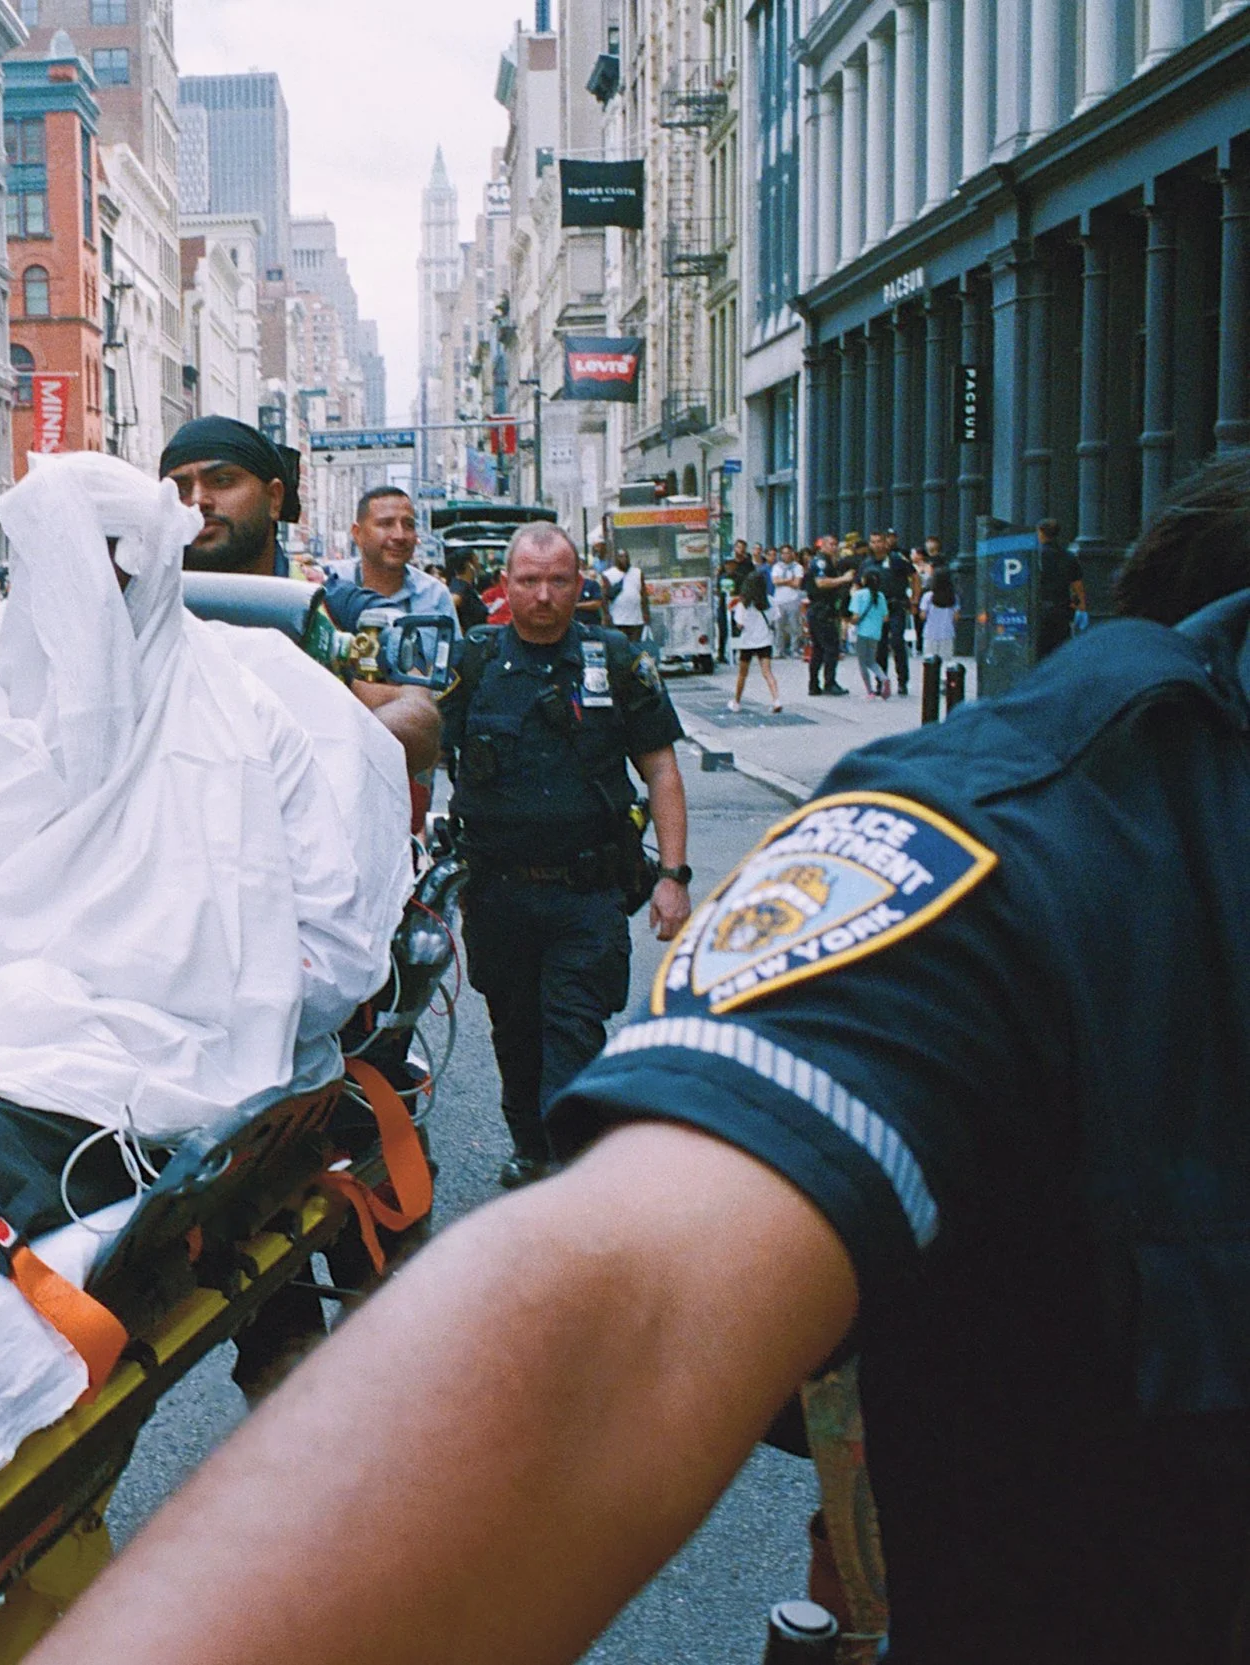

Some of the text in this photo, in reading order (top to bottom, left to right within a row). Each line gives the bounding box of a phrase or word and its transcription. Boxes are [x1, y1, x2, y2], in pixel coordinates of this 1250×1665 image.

[883, 266, 924, 304] PACSUN
[40, 380, 63, 453] MINIS
[965, 368, 977, 439] PACSUN
[1004, 558, 1022, 585] P
[709, 903, 906, 1001] NEW YORK
